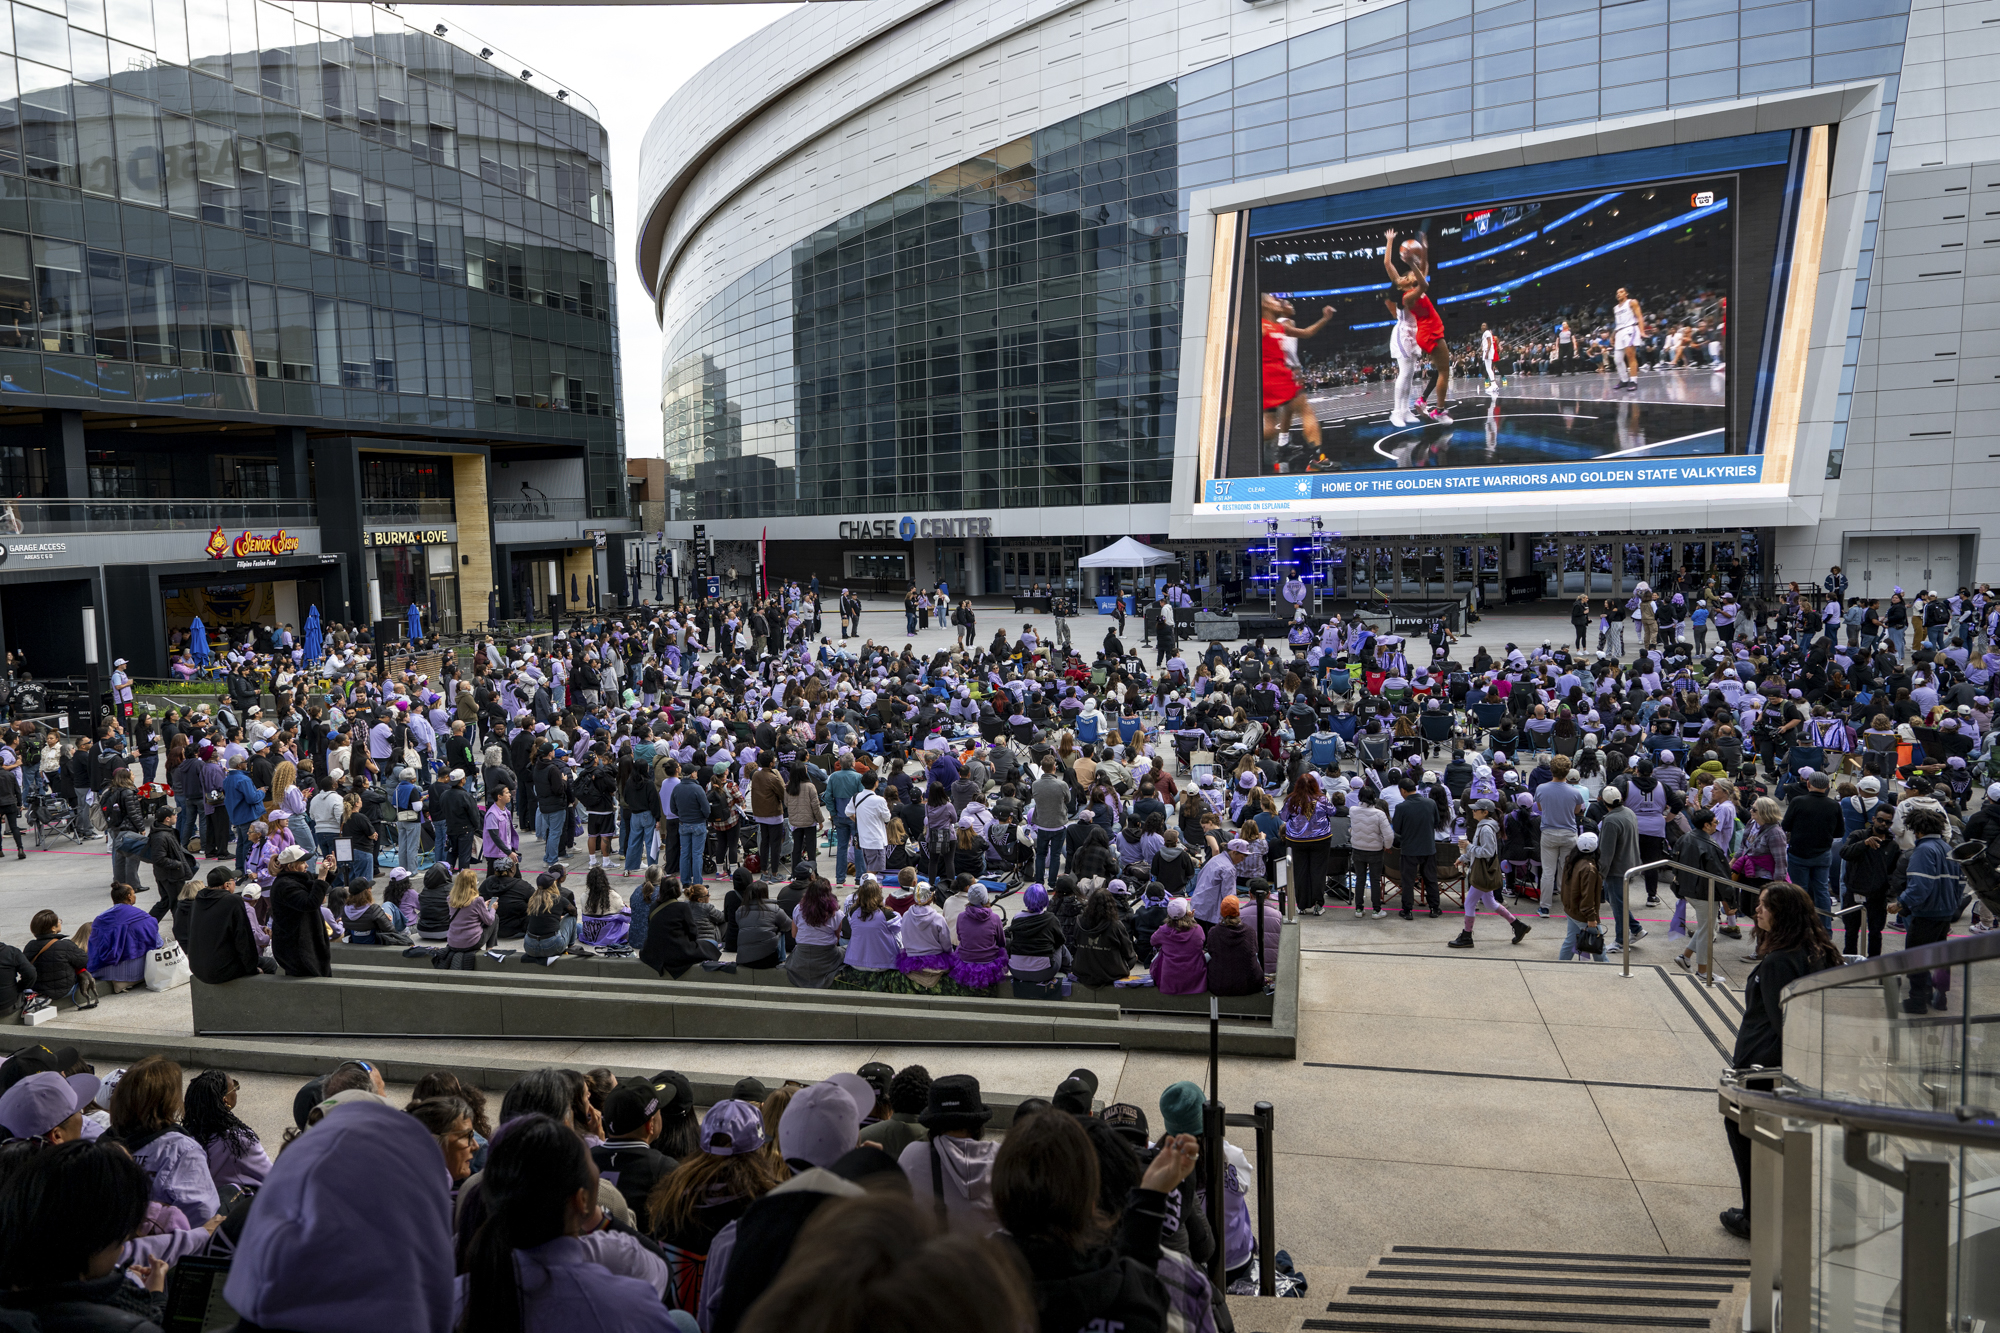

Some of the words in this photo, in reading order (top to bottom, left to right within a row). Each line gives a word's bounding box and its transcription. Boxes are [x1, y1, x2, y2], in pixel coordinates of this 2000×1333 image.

[1321, 482, 1352, 492] HOME
[1354, 481, 1369, 491] OF
[1371, 480, 1393, 491] THE
[1395, 478, 1442, 490] GOLDEN
[1444, 477, 1480, 488] STATE
[1482, 473, 1548, 486] WARRIORS
[1550, 473, 1577, 484] AND
[1580, 471, 1634, 483] GOLDEN
[1637, 468, 1677, 480] STATE
[1681, 465, 1757, 478] VALKYRIES
[1222, 503, 1252, 511] RESTROOMS
[839, 519, 897, 539] CHASE
[920, 517, 993, 538] CENTER
[375, 532, 416, 545] BURMA
[421, 530, 448, 543] LOVE
[9, 544, 37, 552] GARAGE
[39, 543, 66, 551] ACCESS
[1127, 662, 1137, 674] 81
[1103, 1105, 1138, 1120] VALKYRIES
